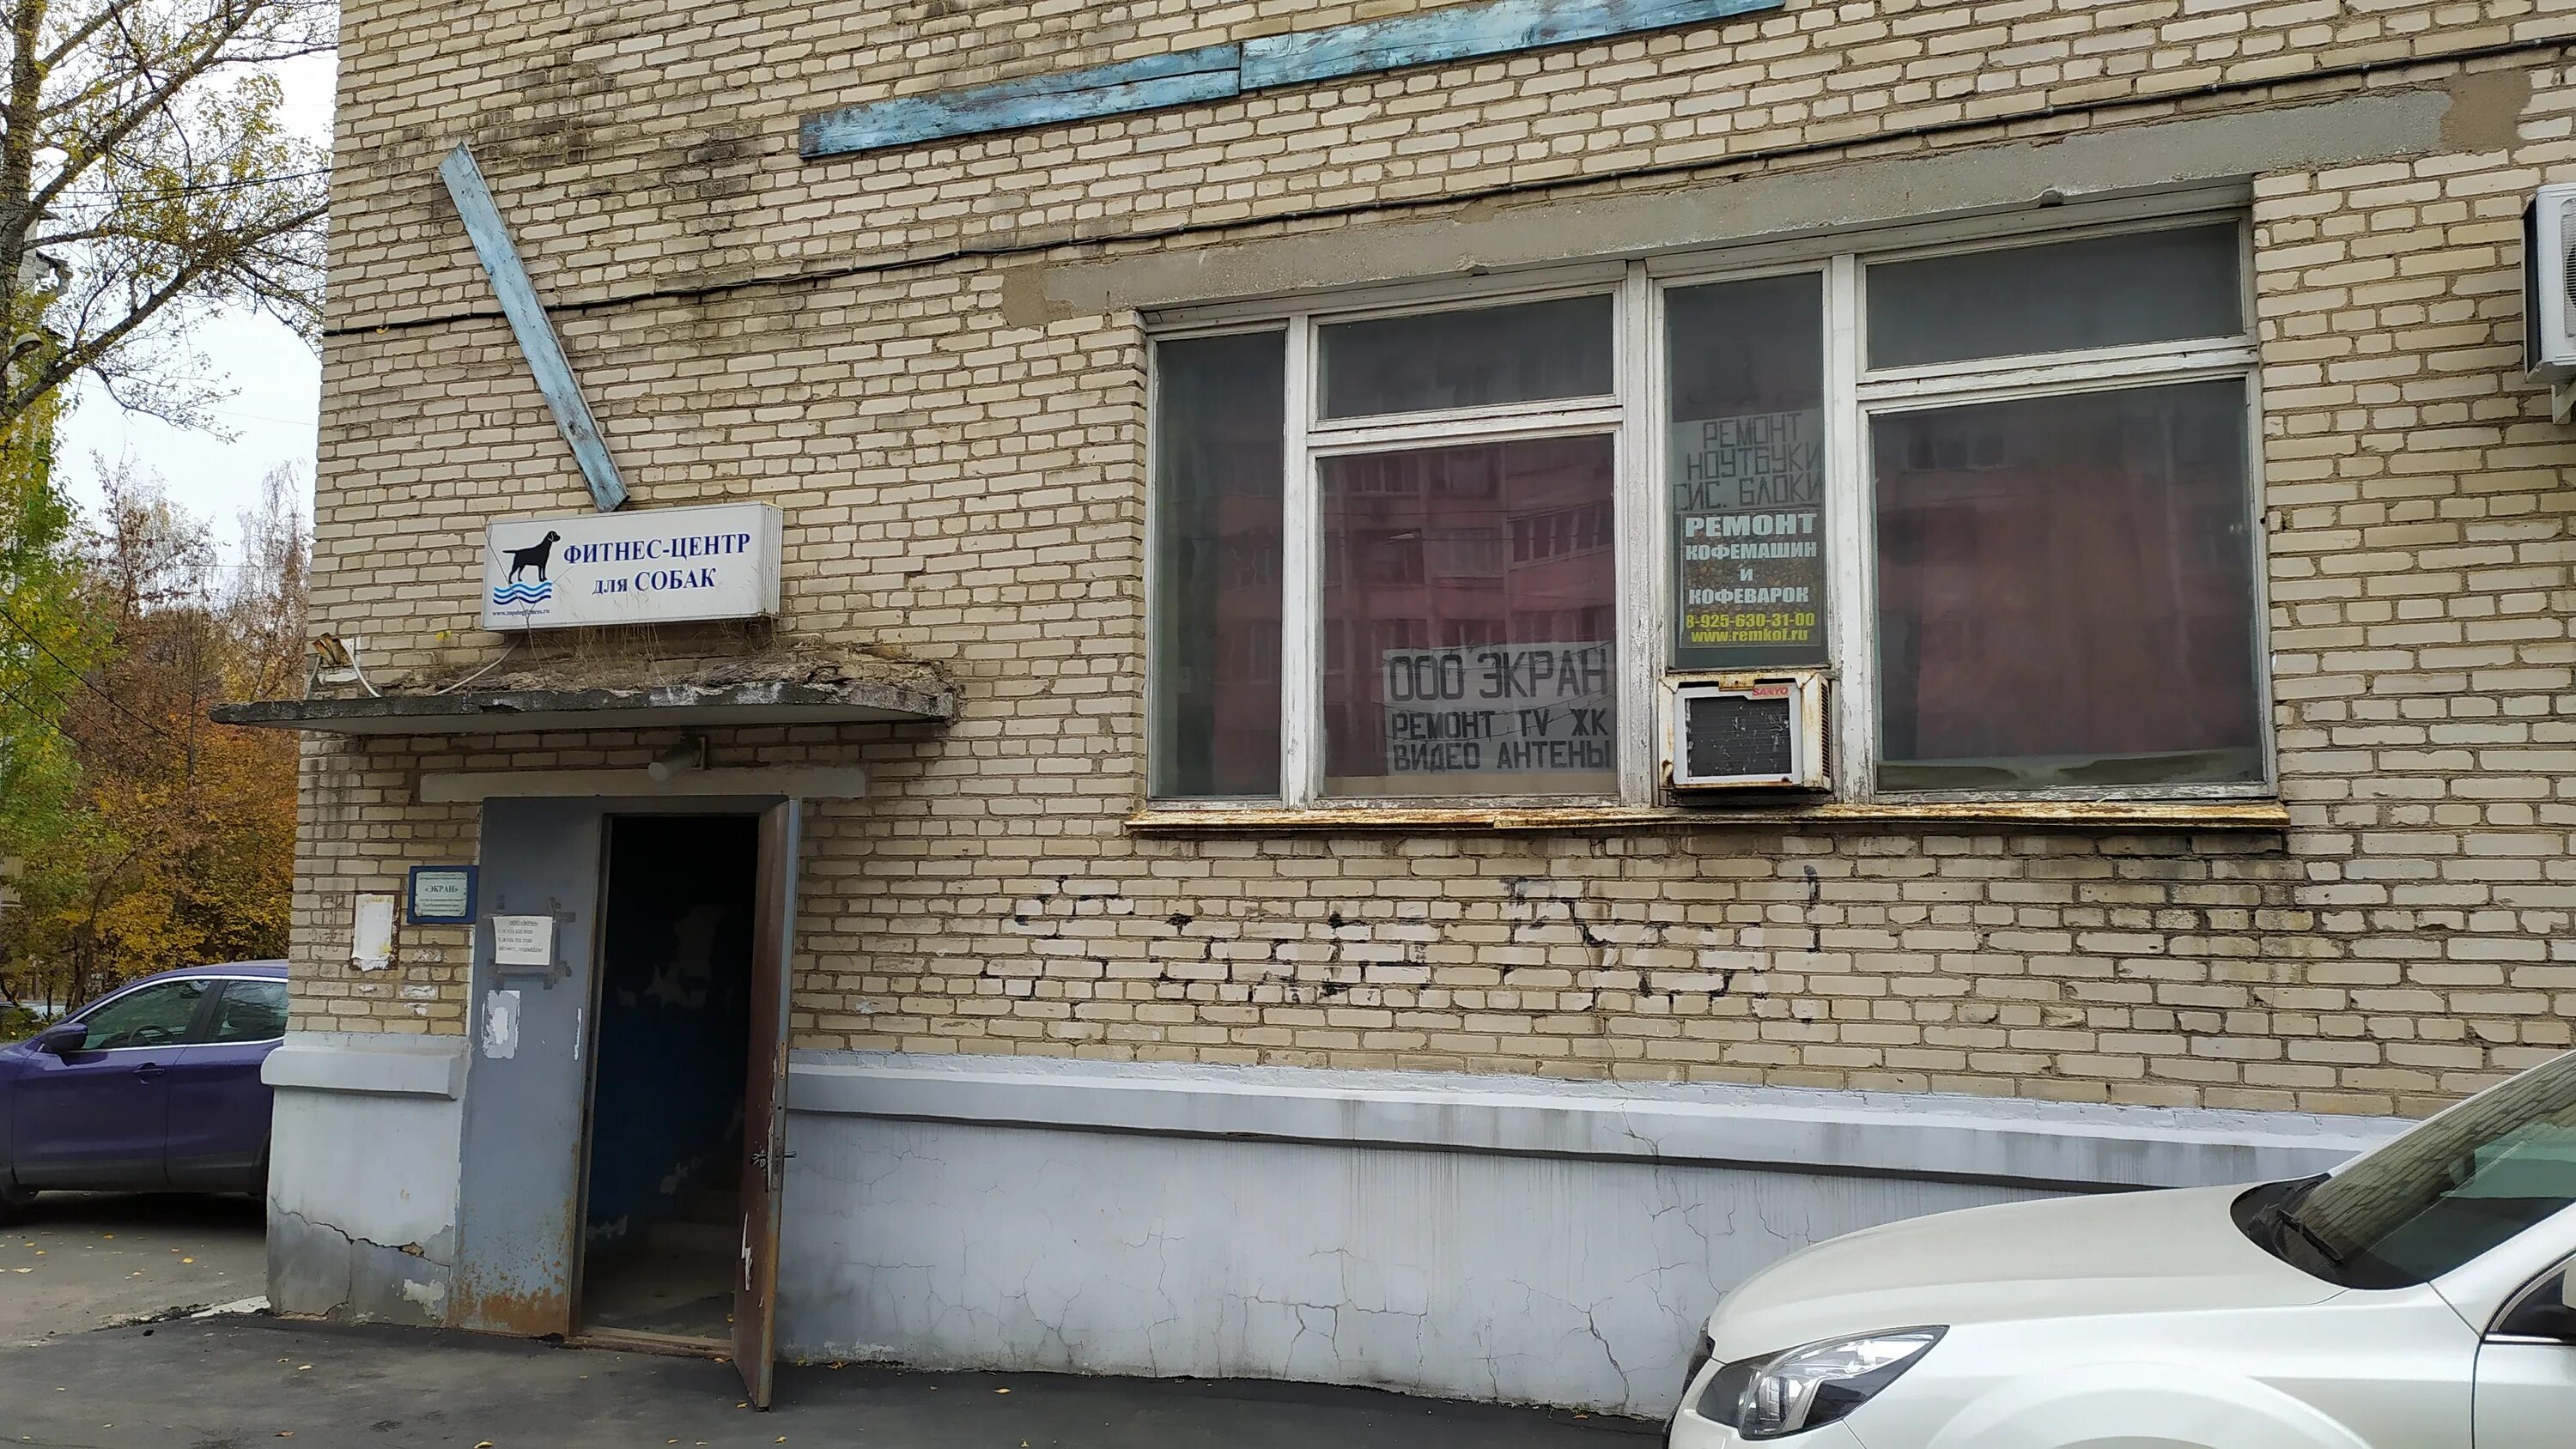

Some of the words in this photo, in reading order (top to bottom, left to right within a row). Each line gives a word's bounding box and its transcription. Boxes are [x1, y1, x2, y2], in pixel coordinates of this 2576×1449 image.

[1703, 412, 1802, 449] РЕМОНТ
[1687, 441, 1821, 481] НОУТБУКИ
[1673, 480, 1727, 511] СИС.
[1739, 473, 1824, 506] БЛОКИ
[1686, 513, 1817, 537] РЕМОНТ
[563, 532, 750, 564] ФИТНЕС-ЦЕНТР
[1686, 542, 1817, 561] КОФЕМАШИН
[592, 578, 628, 596] для
[634, 567, 716, 591] СОБАК
[1689, 586, 1808, 605] КОФЕВАРОК
[1686, 612, 1815, 628] 8-925-630-31-00
[1691, 627, 1808, 642] www.remkof.ru
[1389, 654, 1464, 701] ООО
[1477, 648, 1608, 699] ЭКРАН
[1753, 687, 1788, 696] SANYO
[1391, 710, 1495, 740] РЕМОНТ
[1517, 708, 1549, 737] TV
[1570, 708, 1608, 736] ЖК
[1393, 742, 1481, 772] ВИДЕО
[1497, 740, 1611, 769] АНТЕНЫ
